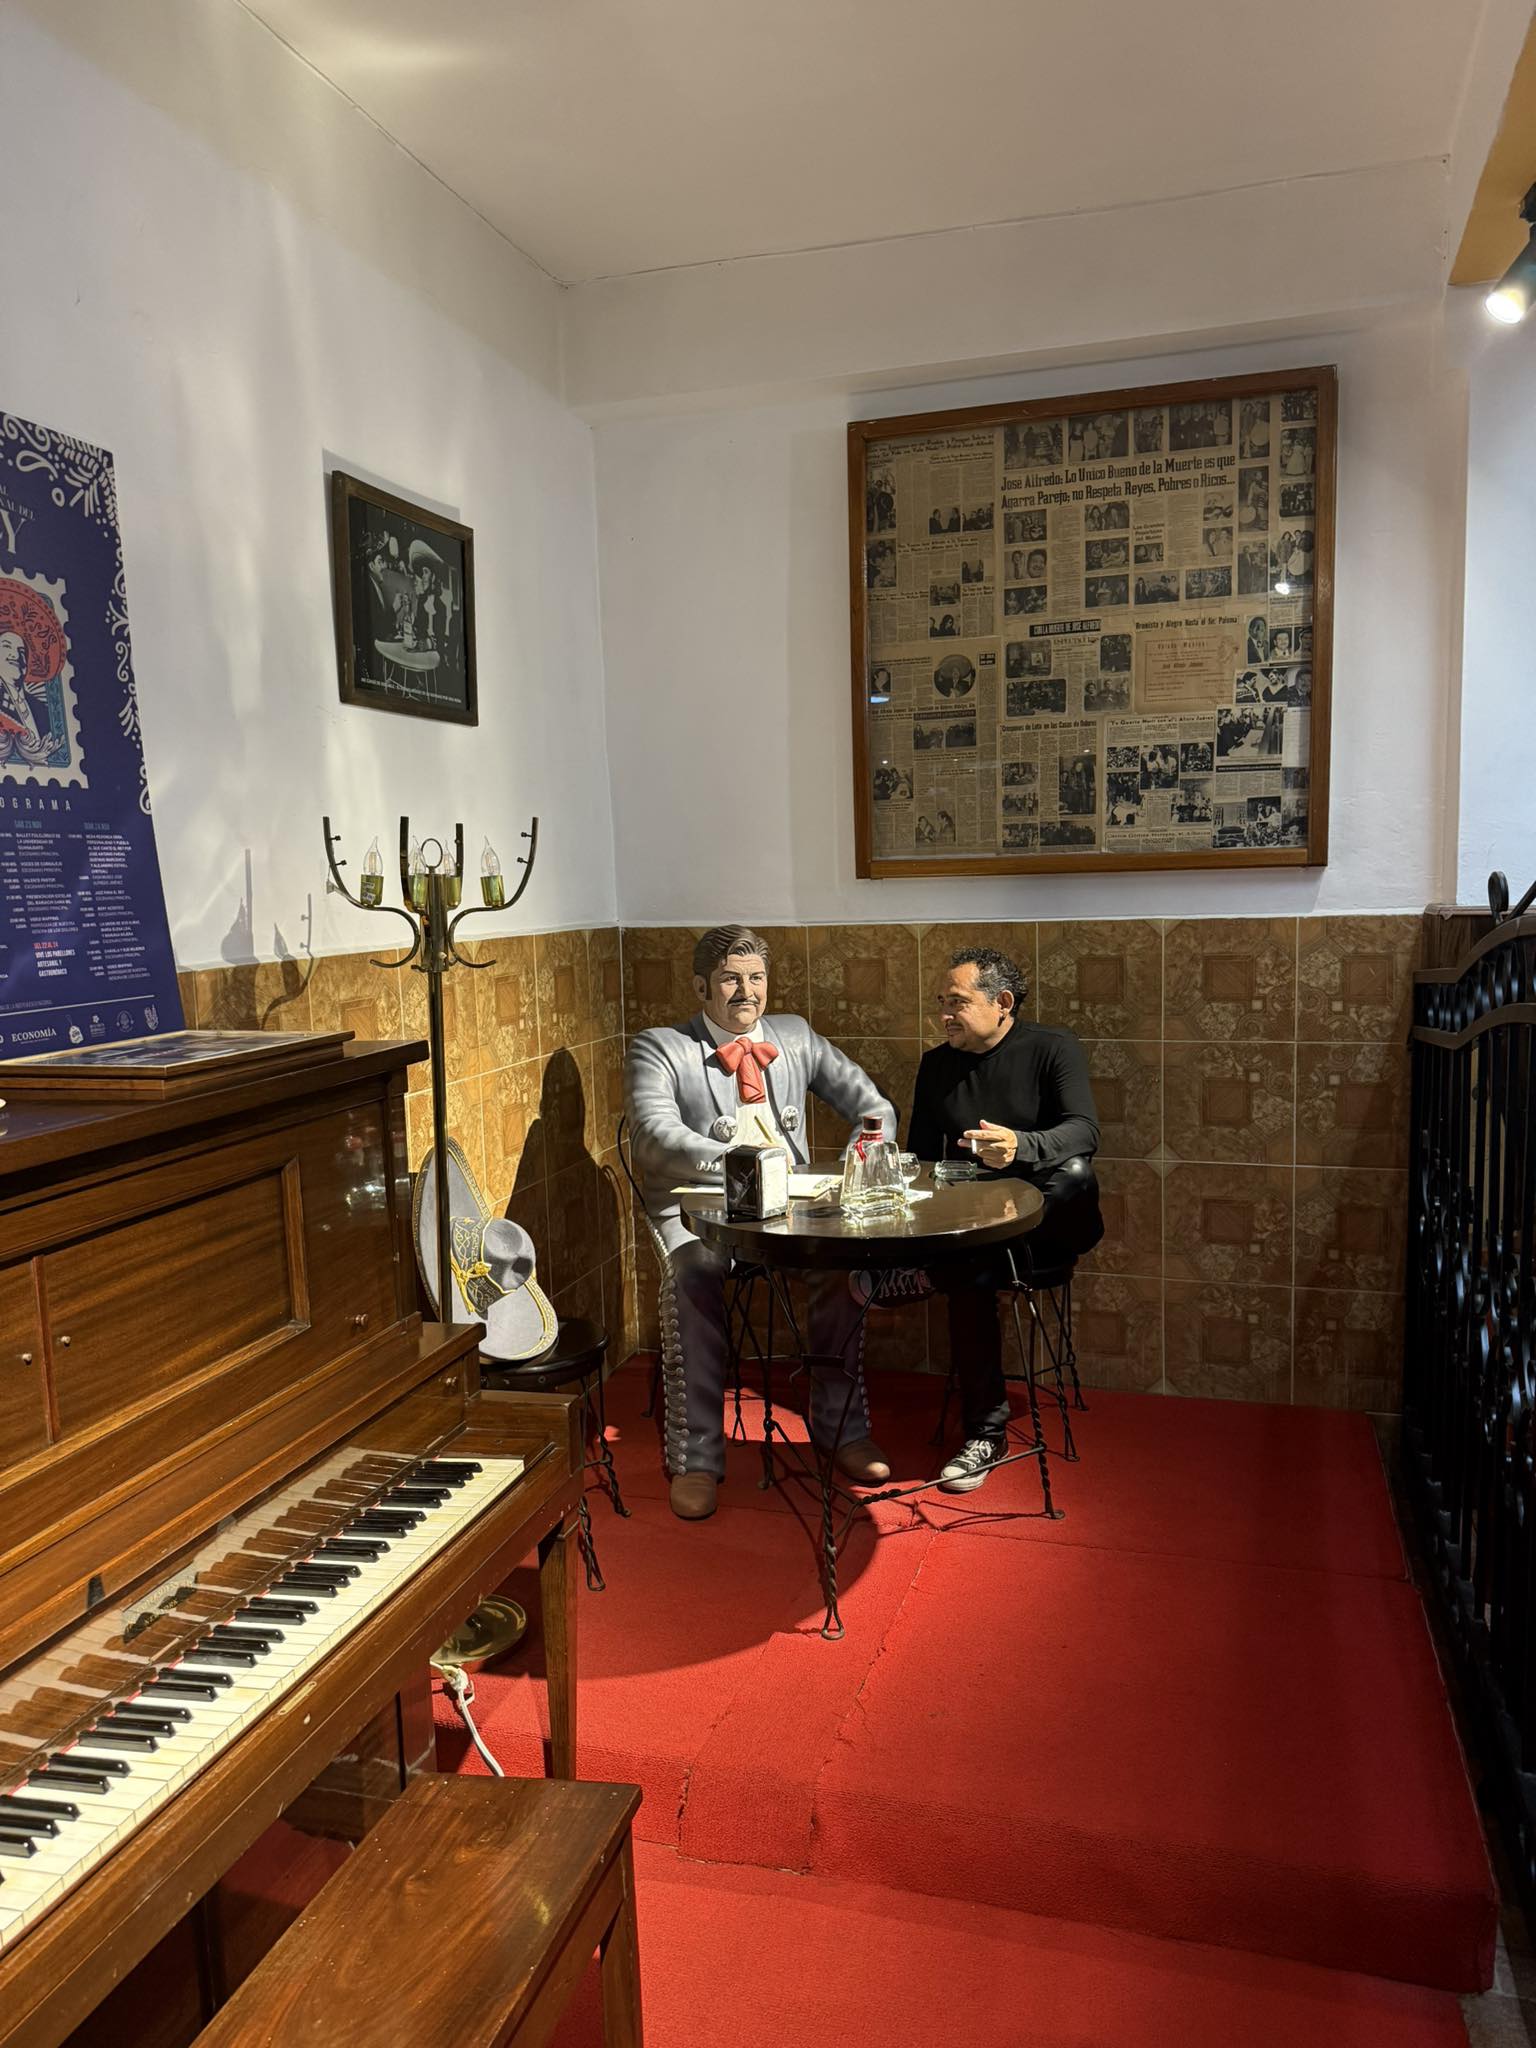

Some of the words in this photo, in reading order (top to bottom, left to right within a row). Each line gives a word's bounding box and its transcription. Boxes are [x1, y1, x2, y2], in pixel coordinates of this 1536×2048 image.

[1065, 470, 1077, 484] Lo
[1108, 465, 1137, 479] Bueno
[1139, 461, 1151, 476] de
[1153, 460, 1163, 474] la
[1165, 456, 1203, 473] Muerte
[1204, 457, 1215, 469] es
[1217, 455, 1236, 471] que
[1001, 495, 1035, 511] Agarra
[1072, 489, 1084, 501] no
[1085, 482, 1122, 501] Respeta
[1158, 476, 1192, 492] Pobres
[1193, 478, 1200, 489] o
[11, 1027, 57, 1042] ECONOMÍA
